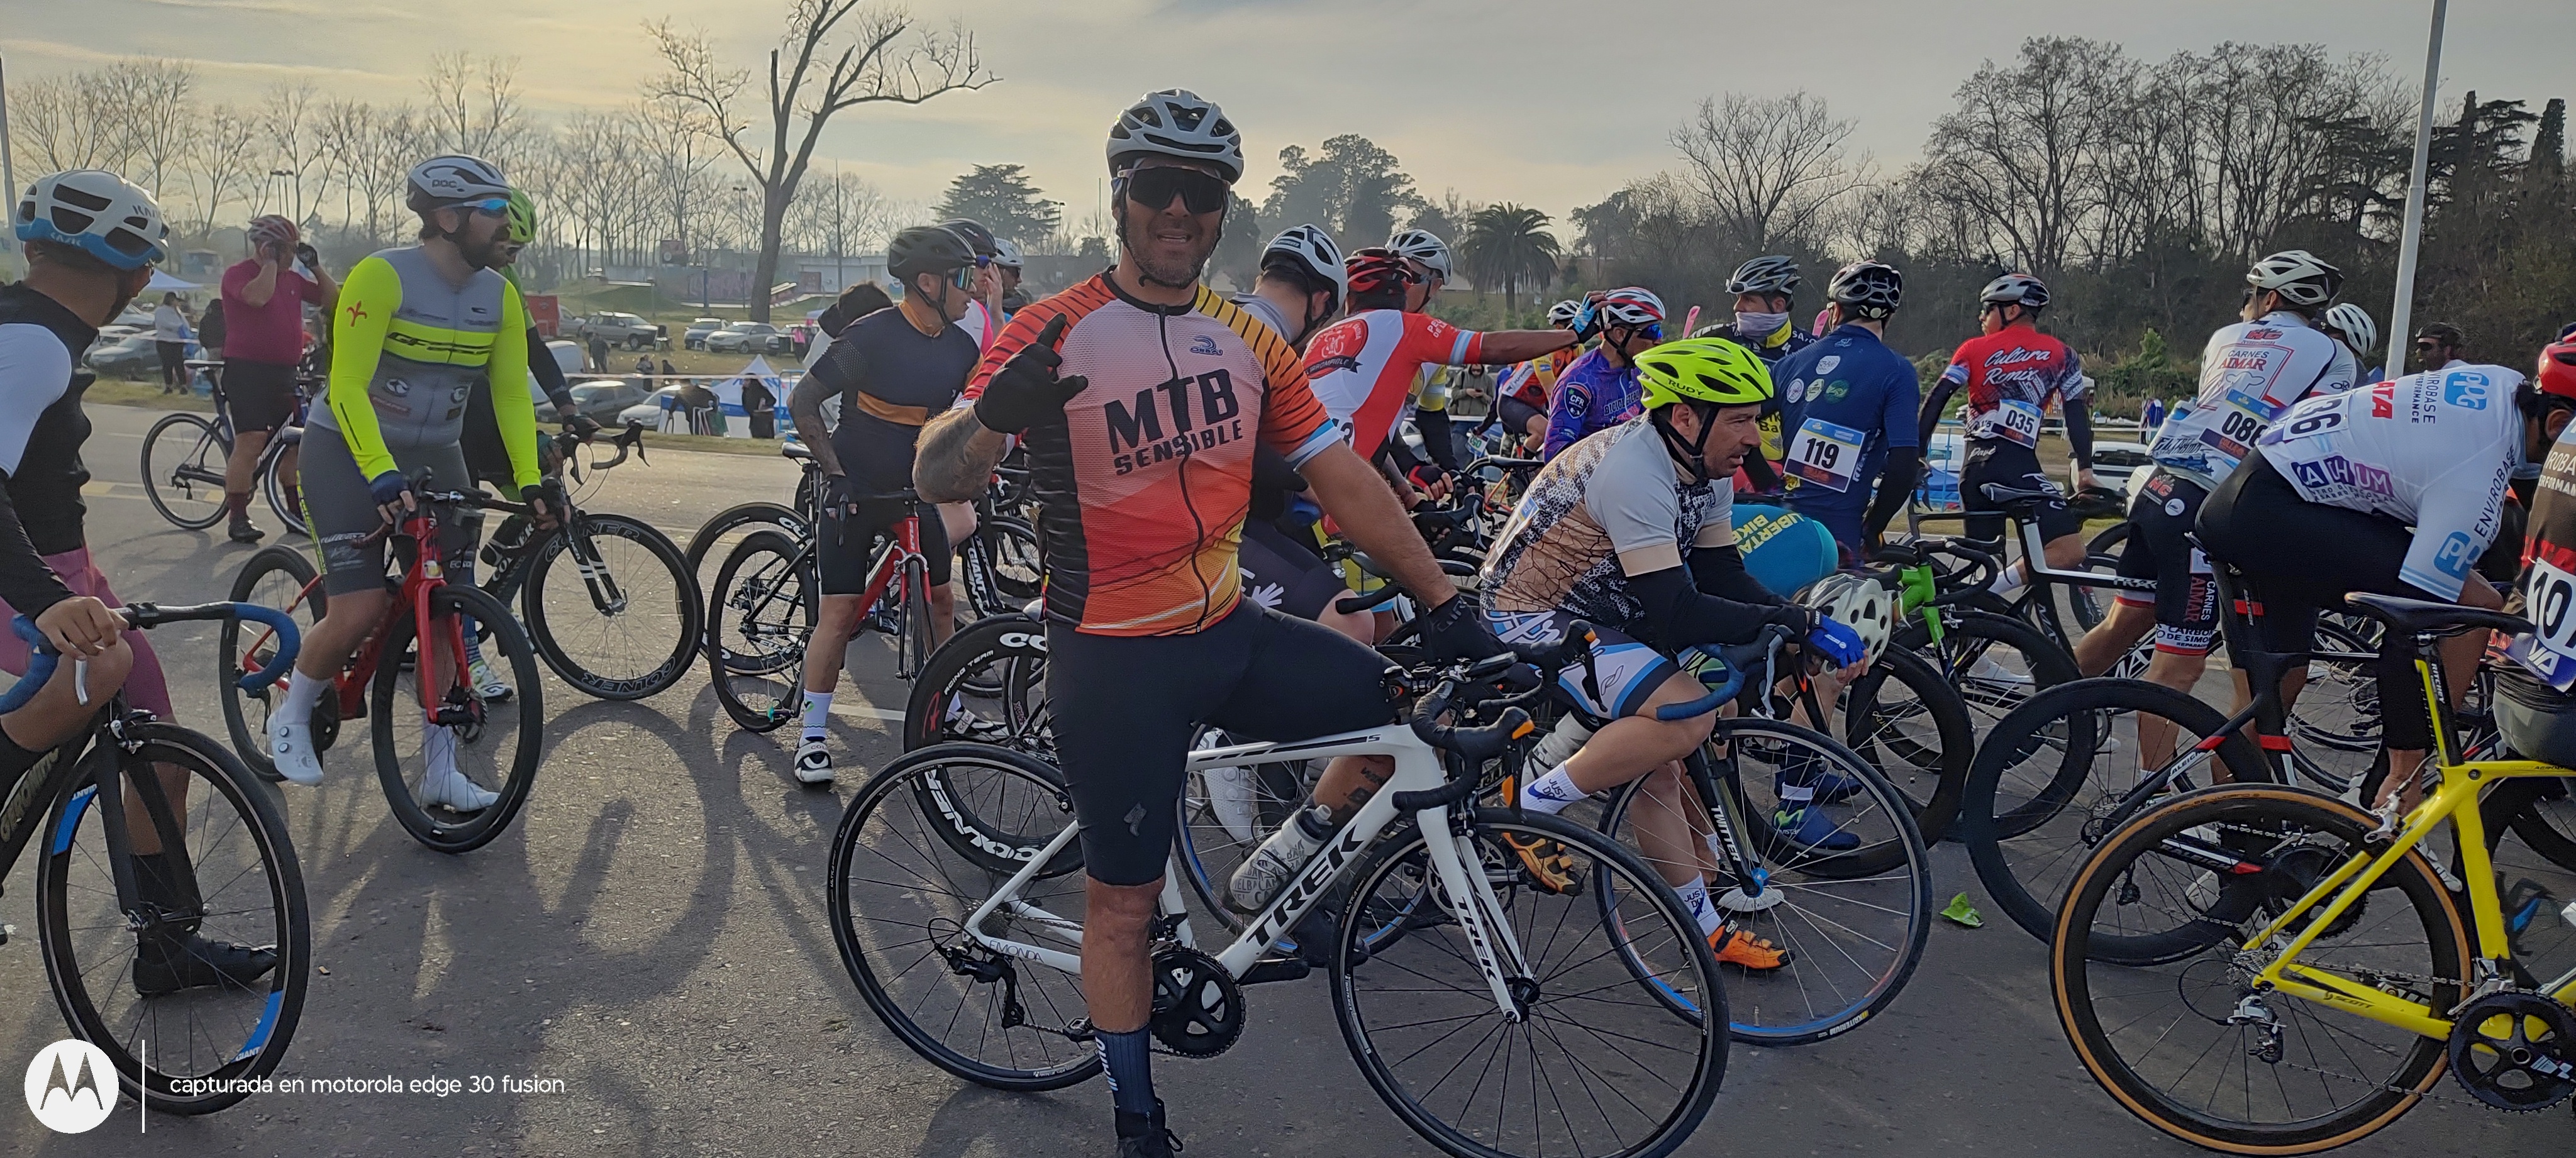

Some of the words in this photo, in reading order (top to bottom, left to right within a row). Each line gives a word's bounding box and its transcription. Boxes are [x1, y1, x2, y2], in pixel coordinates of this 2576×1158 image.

[2281, 288, 2309, 304] RUDY
[1984, 346, 2051, 368] Cultura
[2218, 357, 2268, 372] AIMAR
[2228, 350, 2270, 358] CARNES
[1668, 378, 1706, 397] RUDY
[1104, 368, 1240, 455] MTB
[1570, 394, 1585, 407] CFR
[2372, 382, 2396, 419] ATA
[1759, 422, 1780, 434] Ba
[2005, 409, 2035, 435] 035
[1113, 419, 1243, 476] SENSIBLE
[1804, 438, 1840, 470] 119
[2473, 443, 2515, 539] ENVIROBASE
[967, 546, 989, 593] GIANT
[2201, 580, 2216, 621] CARNES
[2533, 570, 2576, 649] 10
[2166, 633, 2181, 641] DE
[2184, 634, 2212, 643] SIMO
[967, 649, 994, 668] TEAM
[581, 656, 676, 693] COLNER
[2431, 663, 2446, 704] RITCHEY
[72, 783, 97, 801] GIANT
[1548, 778, 1568, 799] JUST
[1711, 805, 1741, 863] TWITTER
[1245, 823, 1365, 947] TREK
[1684, 889, 1706, 903] JUST
[1457, 895, 1499, 982] TREK
[2334, 995, 2376, 1008] SCOTT
[235, 1045, 261, 1062] GIANT
